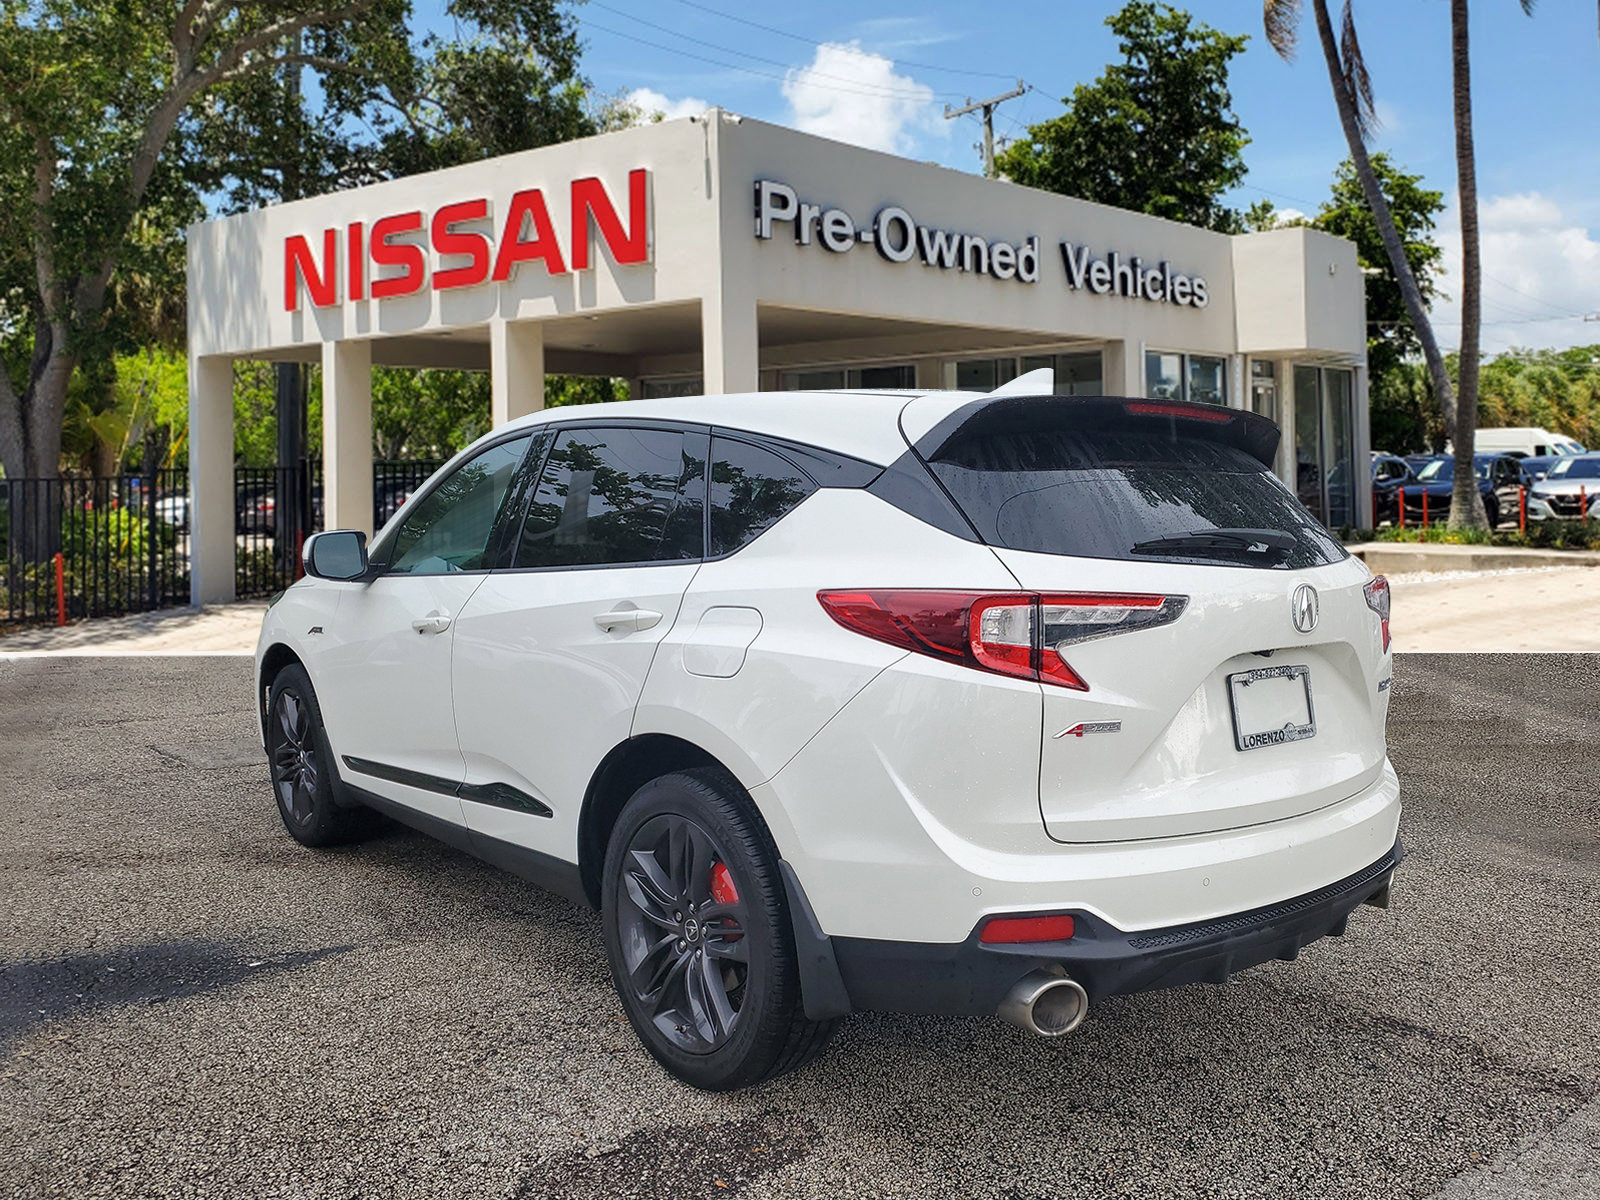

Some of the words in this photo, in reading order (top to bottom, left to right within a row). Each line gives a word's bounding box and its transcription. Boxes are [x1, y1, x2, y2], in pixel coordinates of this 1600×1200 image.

[284, 168, 650, 312] NISSAN
[754, 179, 1041, 283] Pre-Owned
[1059, 242, 1209, 308] Vehicles
[1243, 730, 1285, 748] LORENZO
